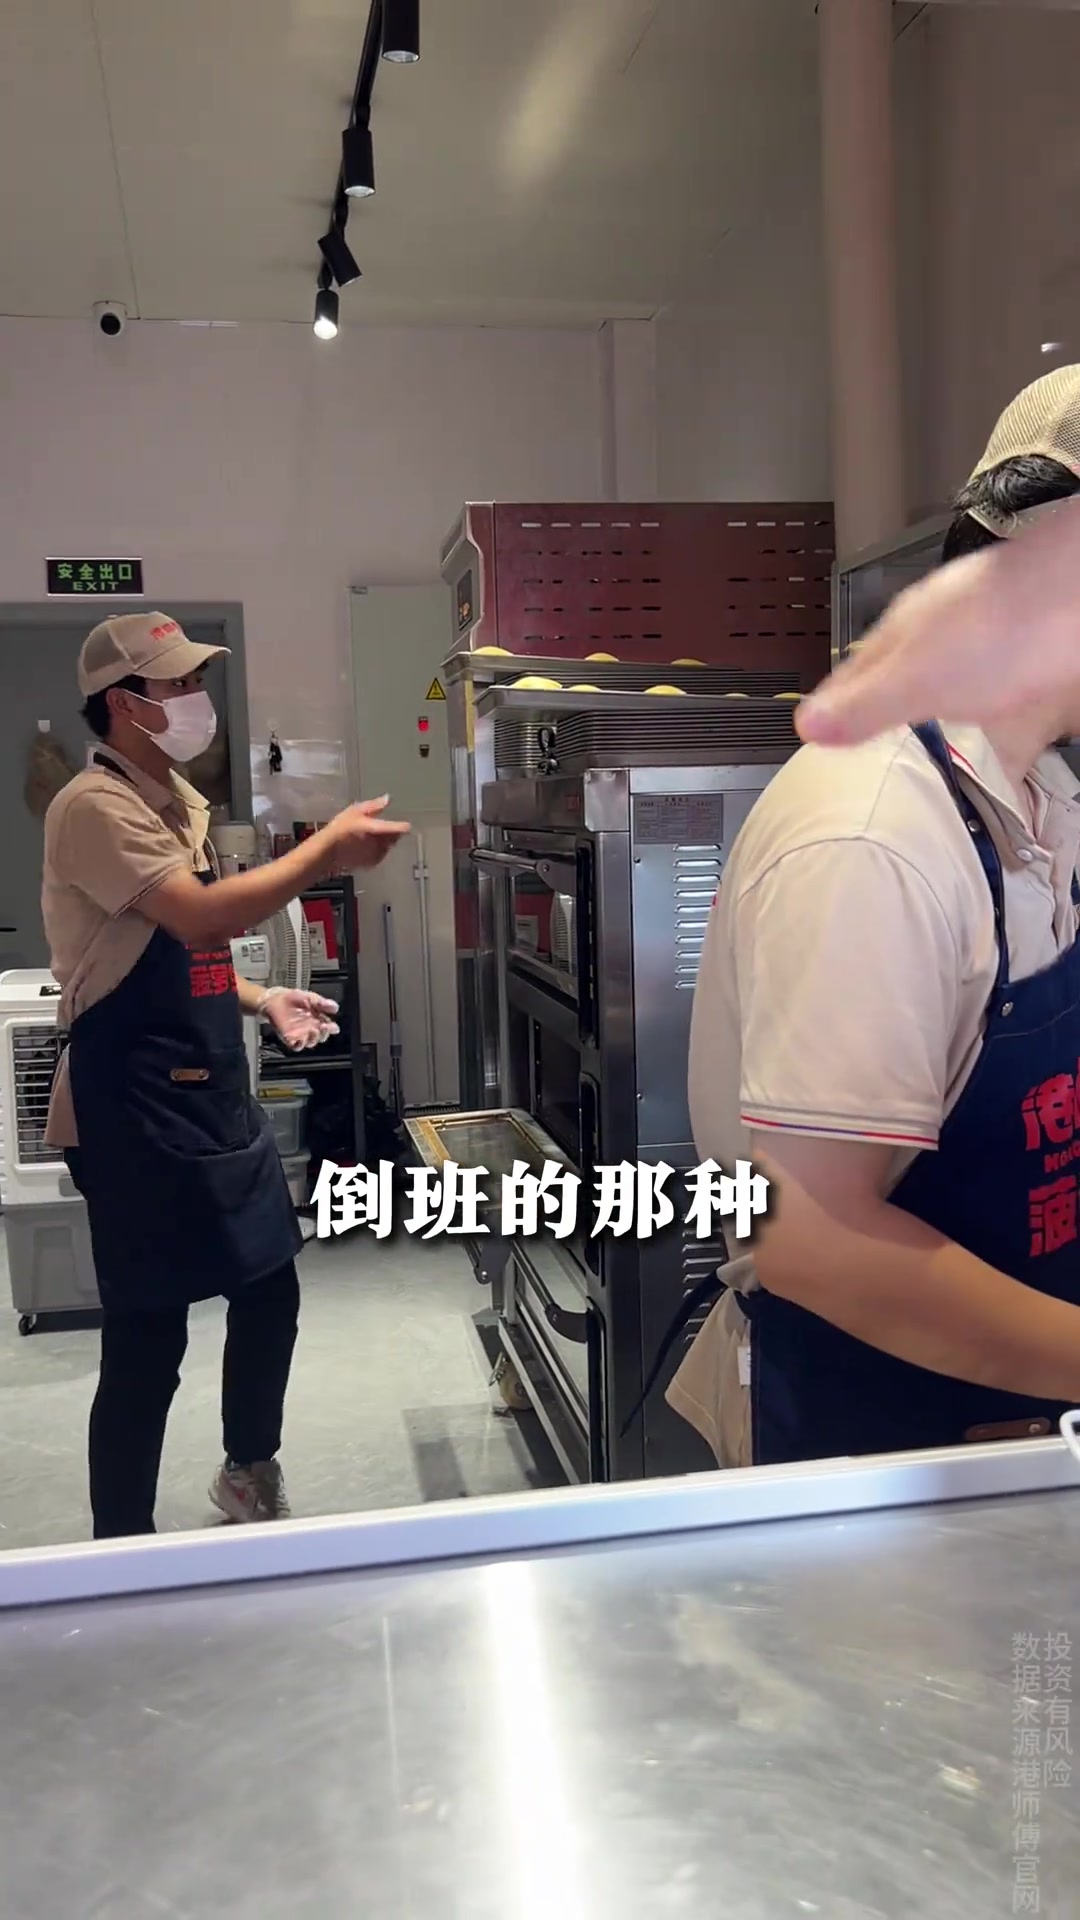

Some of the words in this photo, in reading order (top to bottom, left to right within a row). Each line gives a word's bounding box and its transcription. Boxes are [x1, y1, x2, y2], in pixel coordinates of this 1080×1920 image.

[57, 563, 132, 580] 安全出口
[73, 581, 119, 591] EXIT
